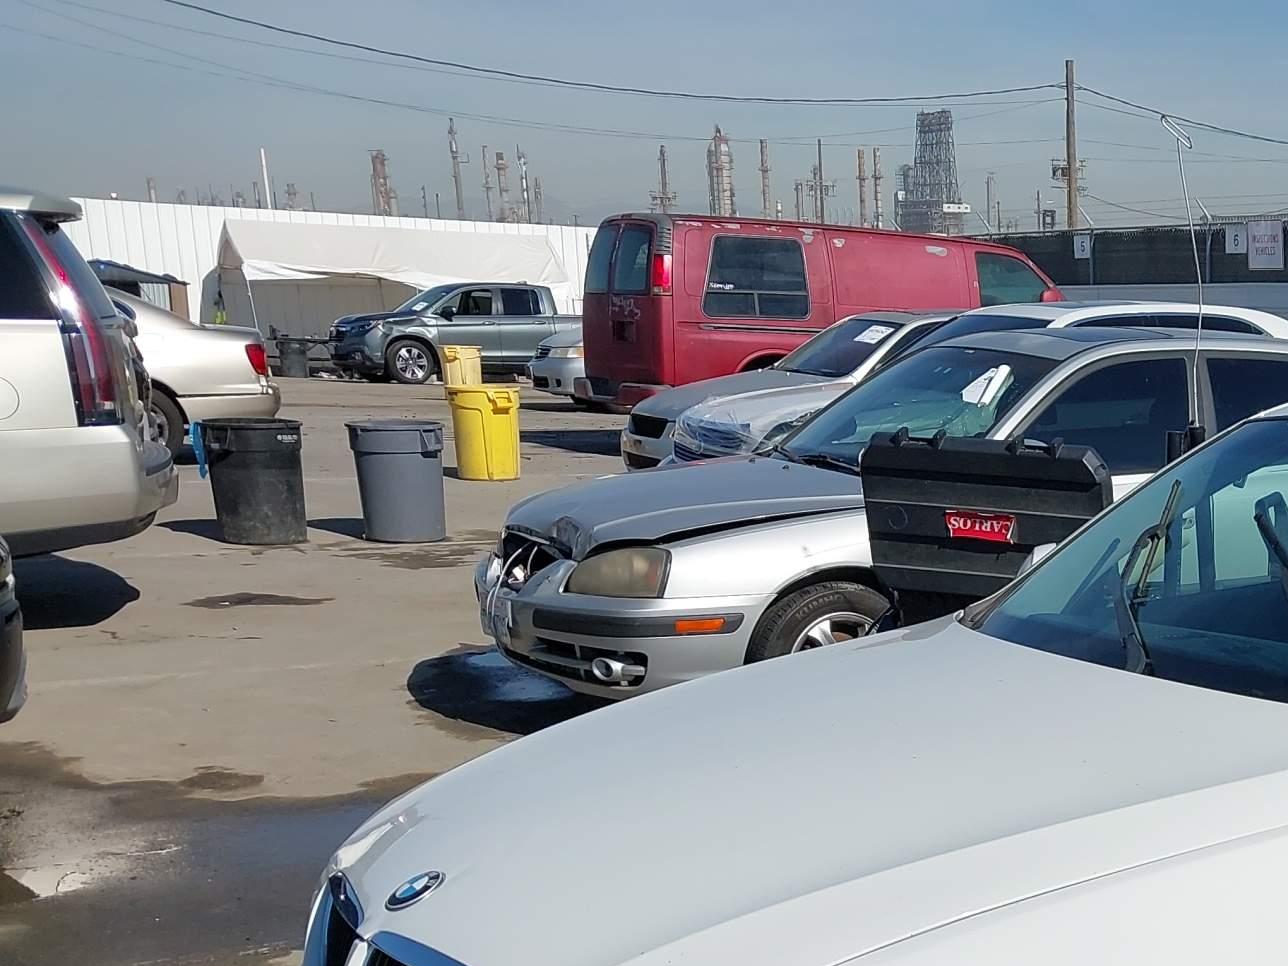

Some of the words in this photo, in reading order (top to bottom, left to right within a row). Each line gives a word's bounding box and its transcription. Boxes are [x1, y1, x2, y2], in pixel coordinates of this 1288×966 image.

[1080, 240, 1086, 252] 5
[1233, 234, 1240, 247] 6
[949, 516, 1011, 534] CARLOS
